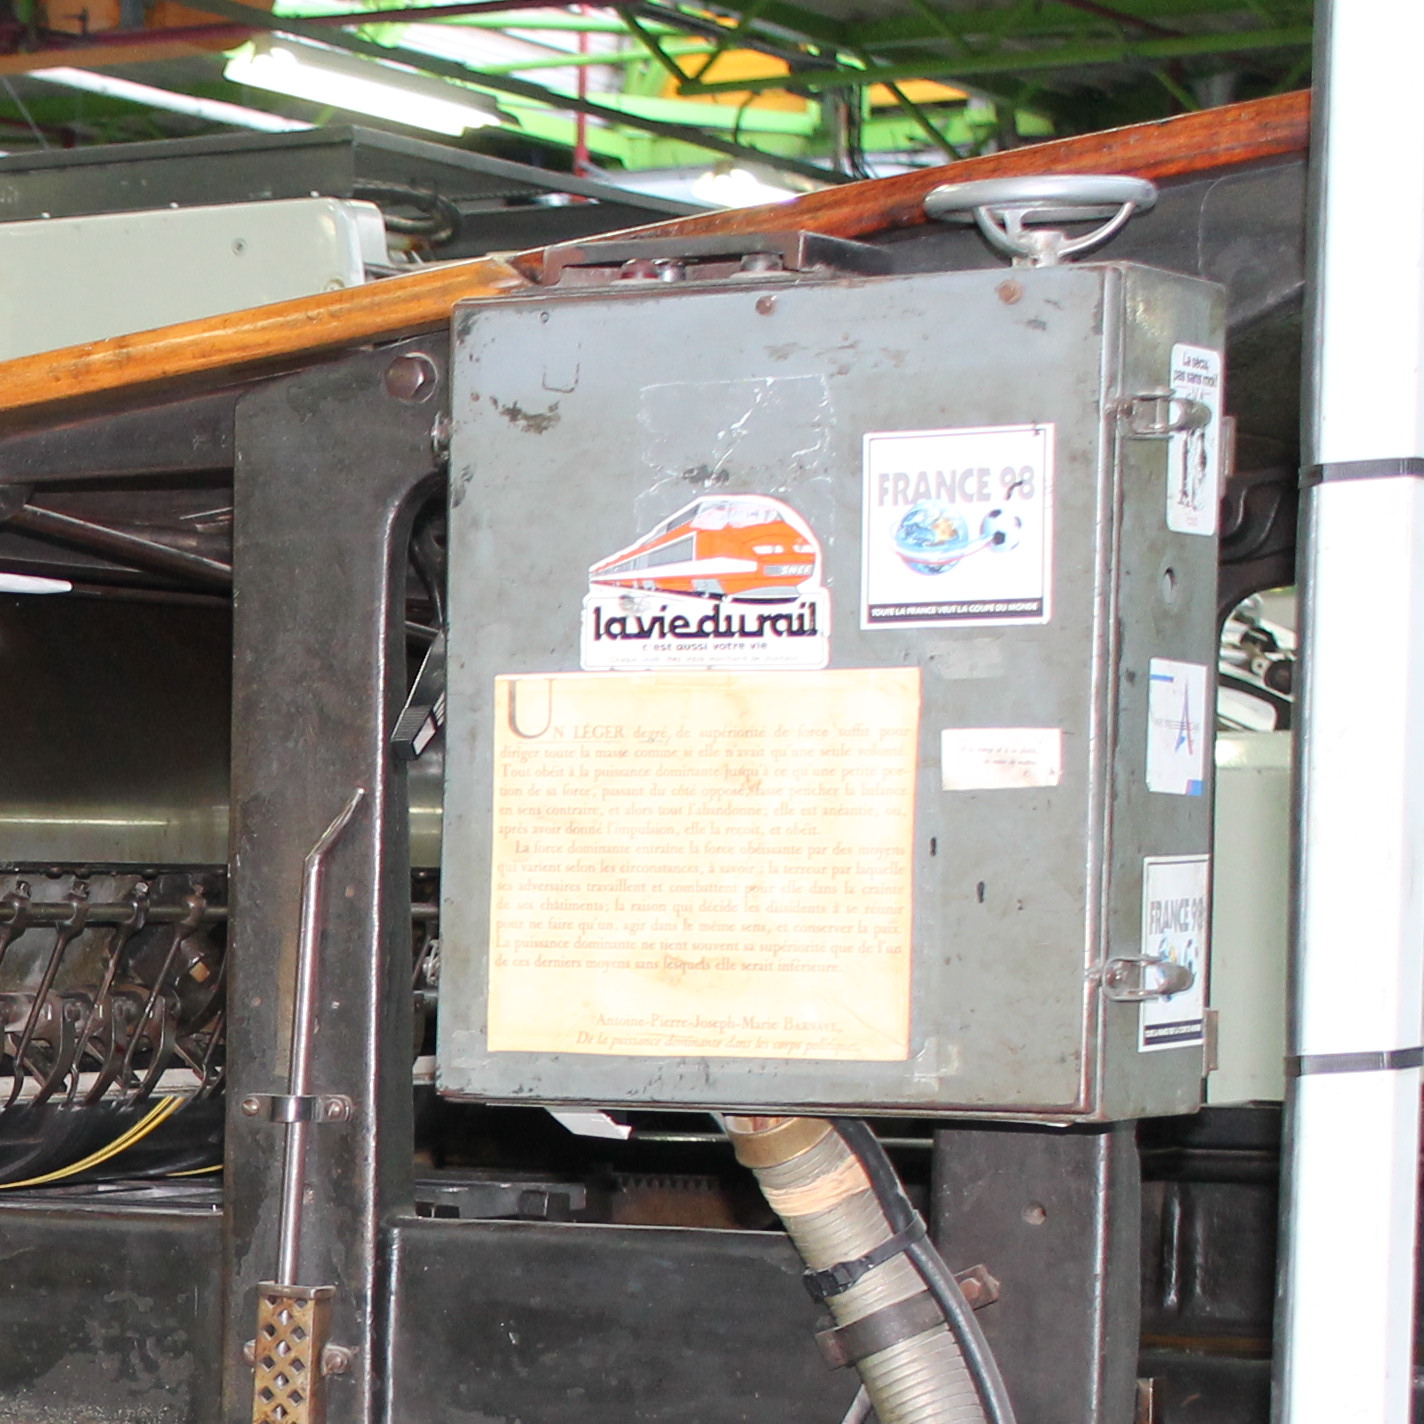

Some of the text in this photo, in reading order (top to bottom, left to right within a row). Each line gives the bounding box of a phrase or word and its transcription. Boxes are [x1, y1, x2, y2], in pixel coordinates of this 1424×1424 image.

[877, 465, 1036, 507] FRANCE 98
[574, 722, 626, 739] LÉGER
[698, 725, 767, 743] supériorité
[796, 724, 830, 738] force
[836, 723, 871, 738] suffit
[878, 728, 910, 742] pour
[498, 744, 540, 763] diriger
[544, 745, 575, 758] toute
[595, 749, 629, 758] masse
[634, 749, 679, 758] comme
[698, 744, 720, 758] elle
[725, 743, 765, 758] n'avait
[771, 743, 814, 762] qu'une
[820, 743, 852, 758] seule
[502, 763, 531, 778] Tout
[535, 763, 564, 778] obéit
[594, 764, 651, 782] puissance
[656, 763, 721, 777] dominante
[794, 762, 836, 781] qu'une
[841, 763, 876, 781] petite
[497, 783, 523, 797] tion
[562, 782, 597, 799] force,
[602, 783, 645, 801] passant
[671, 783, 696, 797] côté
[862, 782, 910, 797] balance
[546, 802, 604, 818] contraire,
[624, 802, 654, 816] alors
[658, 802, 683, 816] tout
[774, 802, 795, 816] elle
[497, 822, 529, 840] après
[532, 822, 561, 835] avoir
[565, 821, 602, 835] donné
[684, 821, 705, 836] elle
[725, 822, 765, 840] reçoit,
[534, 840, 563, 855] force
[568, 840, 631, 855] dominante
[704, 841, 735, 855] force
[521, 860, 561, 874] varient
[565, 860, 596, 874] selon
[783, 862, 827, 875] terreur
[856, 861, 908, 880] laquelle
[518, 879, 906, 899] adversaires travaillent combattent pour elle dans crainte
[630, 899, 667, 913] raison
[698, 899, 737, 913] décide
[766, 900, 827, 914] dissidents
[864, 901, 905, 915] réunir
[1149, 898, 1189, 936] FRANCE
[495, 921, 524, 935] pour
[548, 916, 574, 931] faire
[622, 918, 646, 936] agir
[651, 917, 677, 932] dans
[793, 924, 853, 934] conserver
[514, 937, 826, 958] puissance dominante tient souvent supériorité
[534, 954, 582, 969] derniers
[634, 961, 659, 970] sans
[715, 957, 736, 971] elle
[740, 958, 774, 971] serait
